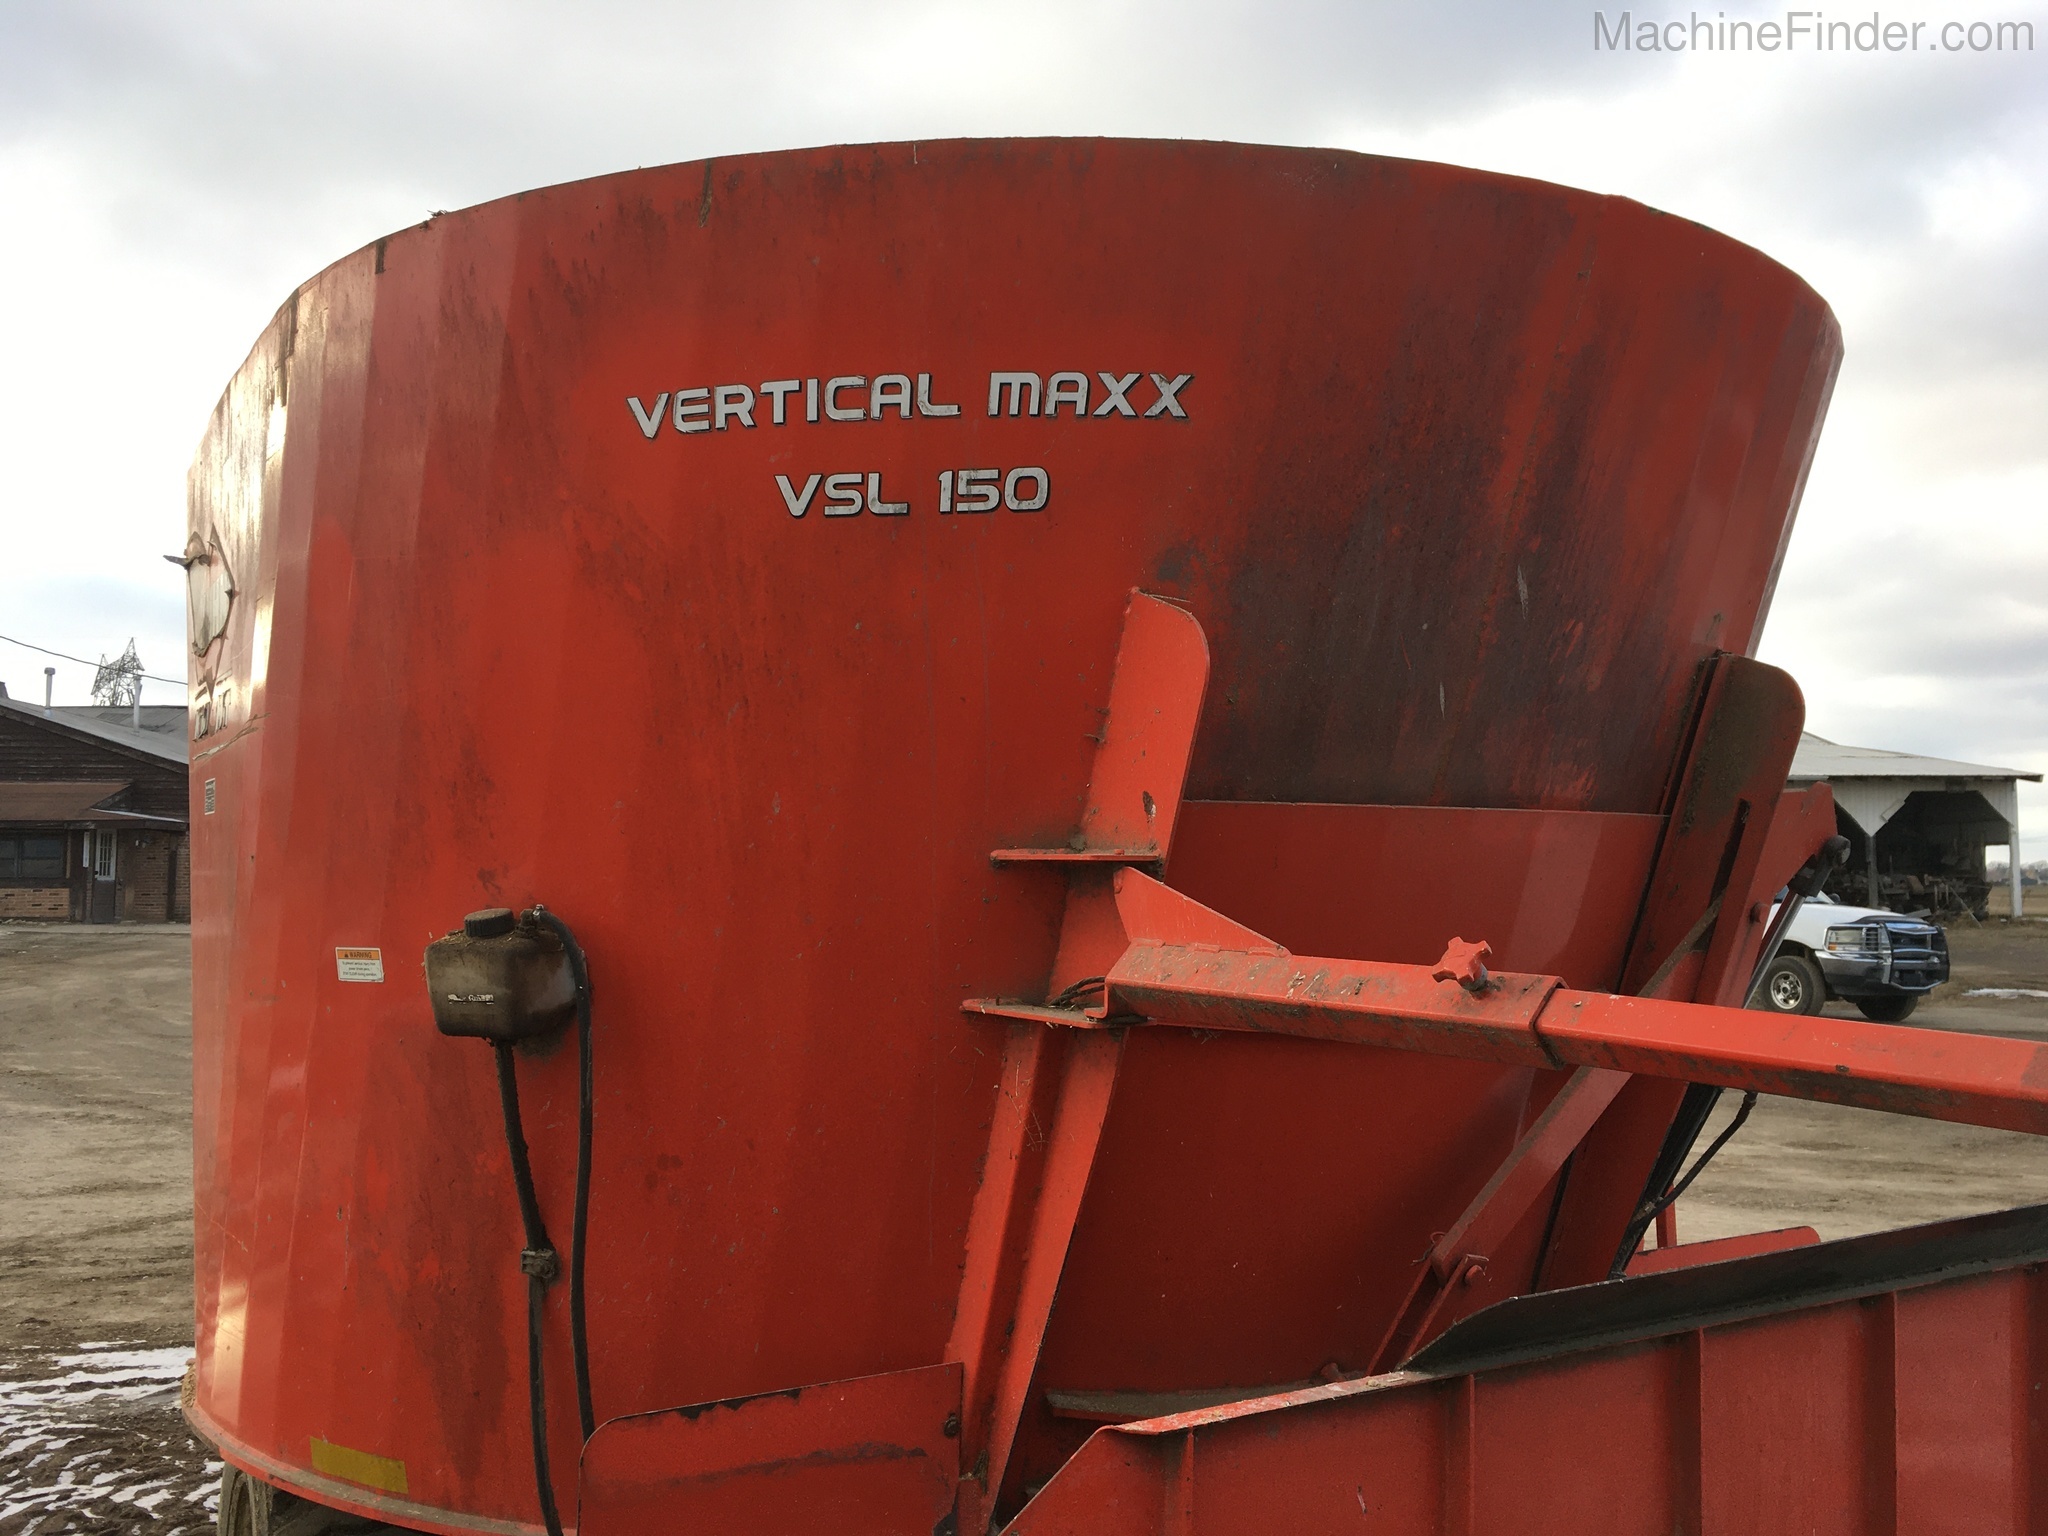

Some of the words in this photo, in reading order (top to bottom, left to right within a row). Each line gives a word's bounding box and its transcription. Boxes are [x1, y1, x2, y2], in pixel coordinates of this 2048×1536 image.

[626, 371, 962, 440] VERTICAL
[987, 371, 1195, 418] MAXX
[774, 471, 909, 518] VSL
[939, 466, 1051, 513] 150
[349, 951, 373, 959] WARNING
